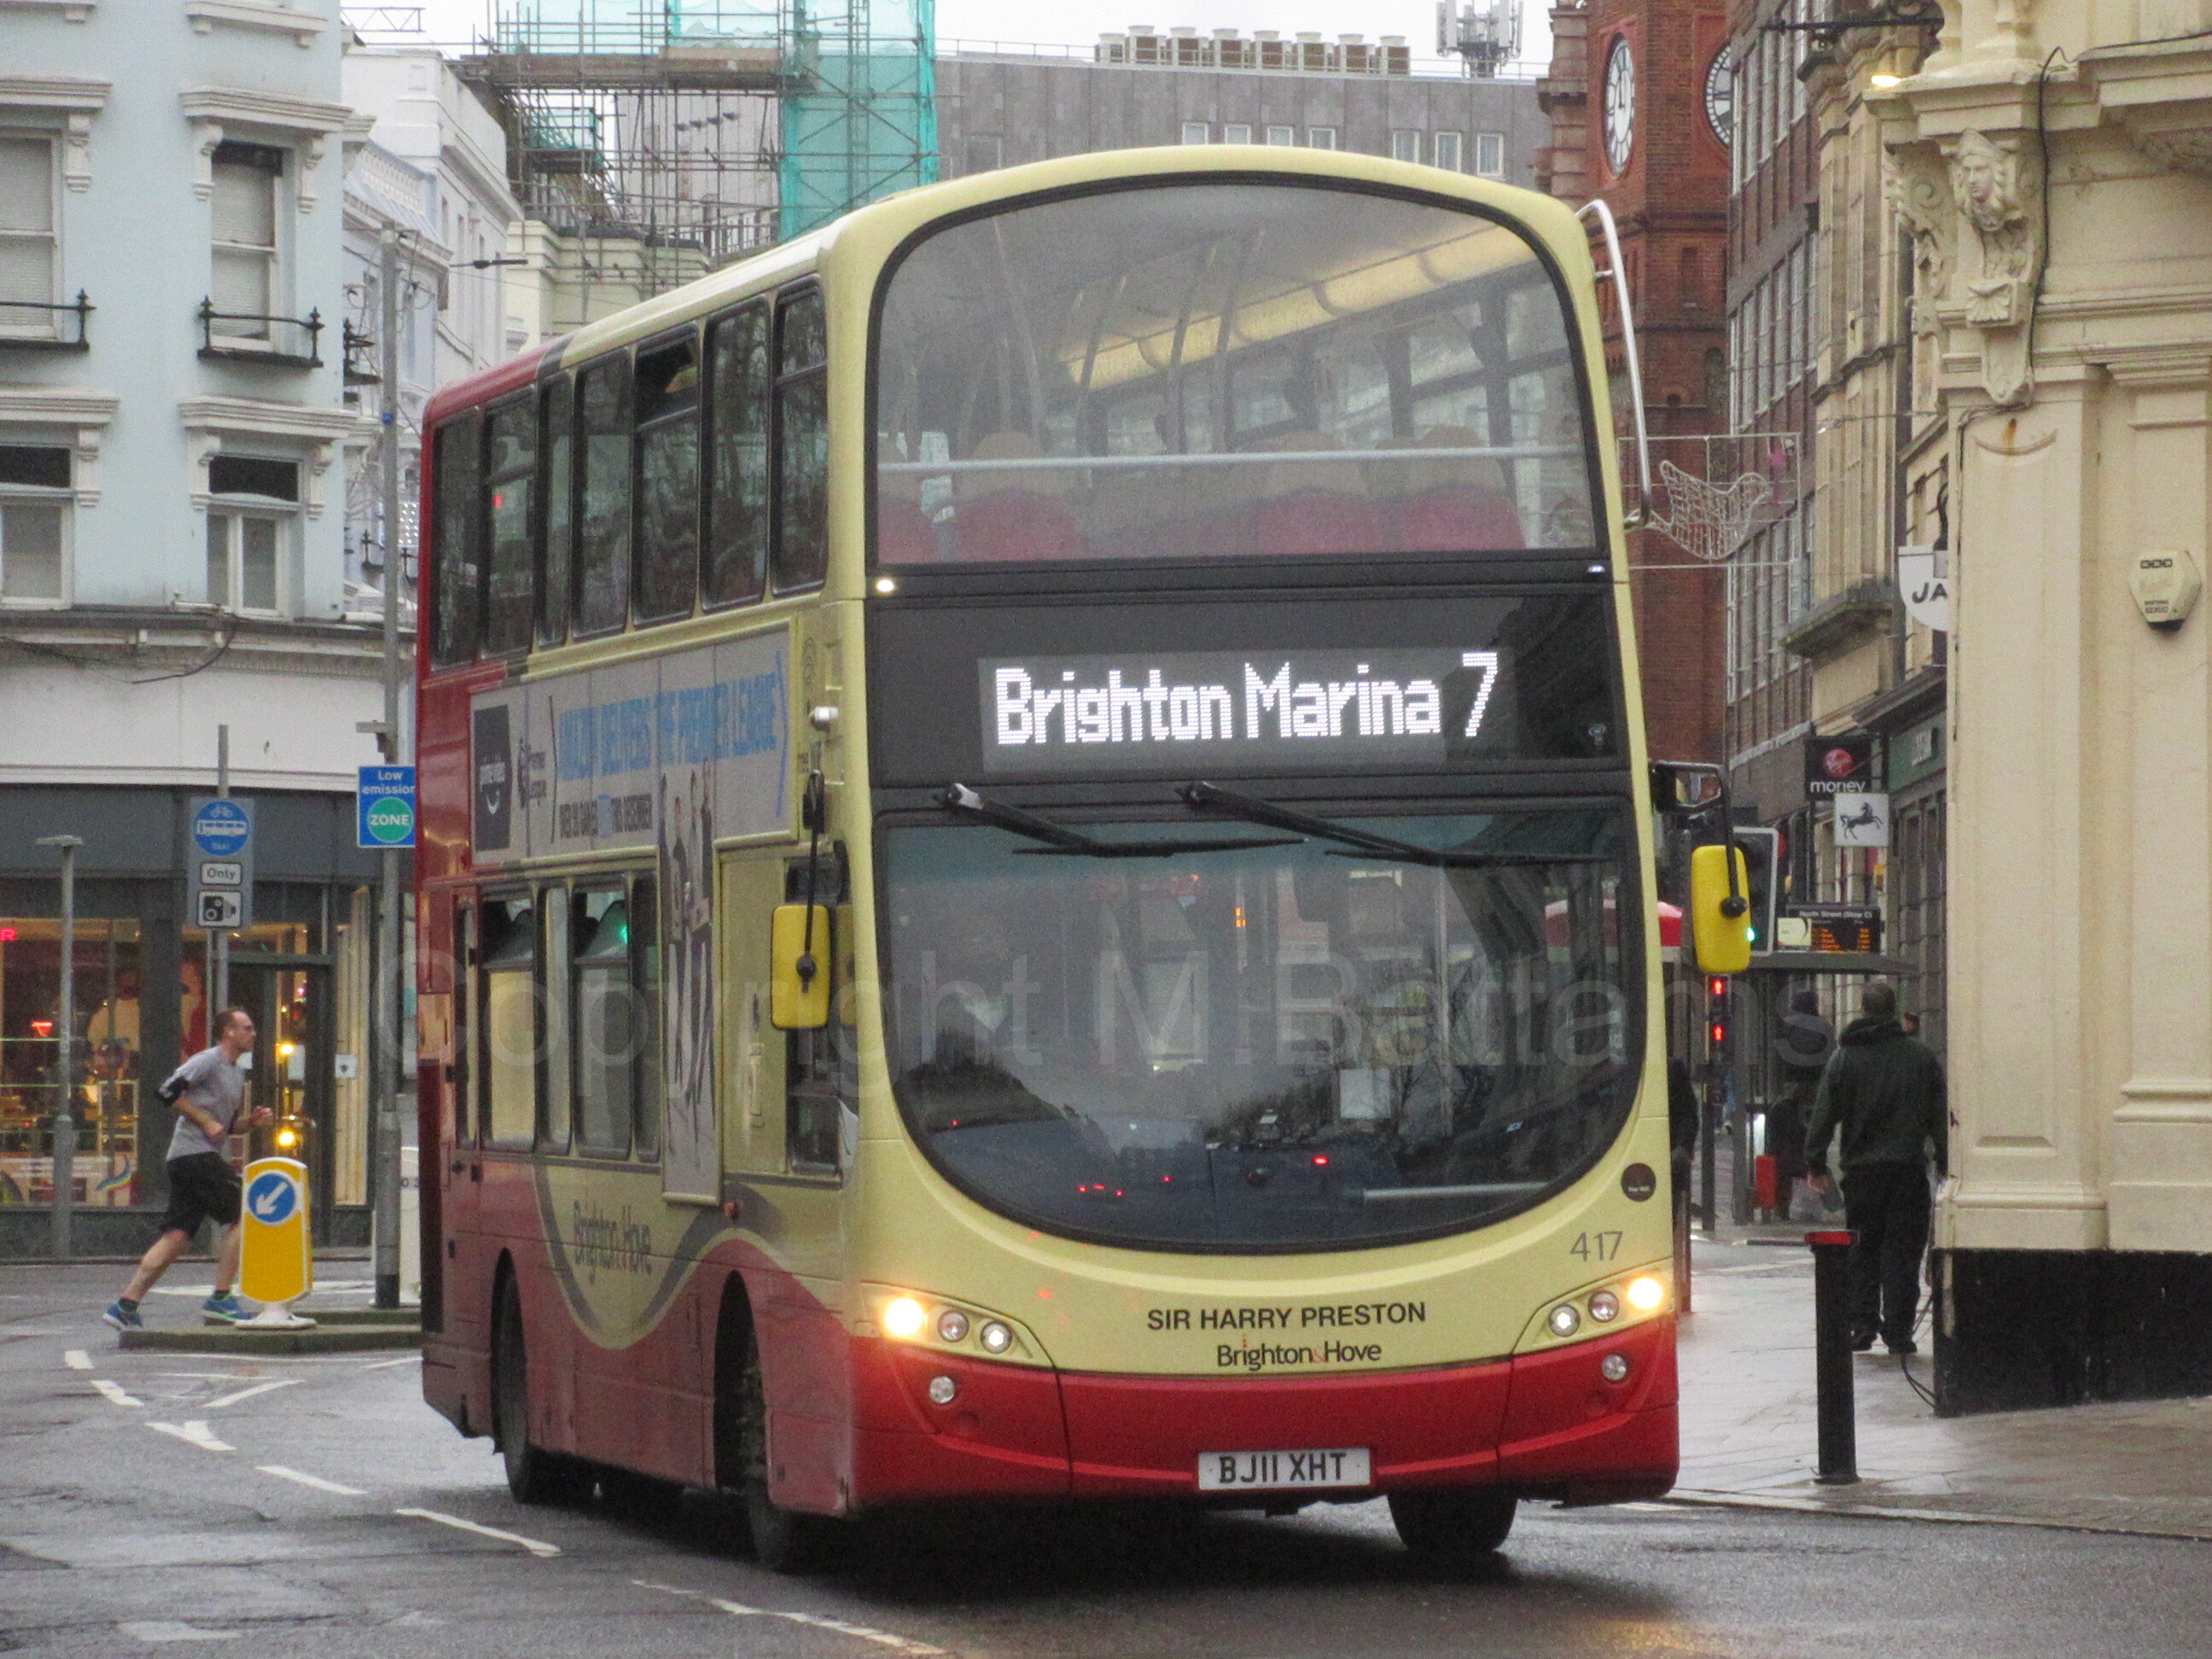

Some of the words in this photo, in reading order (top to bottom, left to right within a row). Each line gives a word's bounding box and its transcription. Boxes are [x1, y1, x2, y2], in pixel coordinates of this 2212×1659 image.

[995, 666, 1233, 746] Brighton
[1243, 661, 1441, 741] Marina
[1462, 651, 1499, 739] 7
[378, 769, 404, 781] Low
[1810, 779, 1866, 793] money
[370, 814, 410, 826] ZONE
[207, 868, 236, 880] Only
[1569, 1231, 1624, 1262] 417
[1146, 1308, 1190, 1331] SIR
[1200, 1307, 1293, 1330] HARRY
[1301, 1301, 1427, 1328] PRESTON
[1218, 1454, 1279, 1484] BJ11
[1289, 1452, 1347, 1482] XHT
